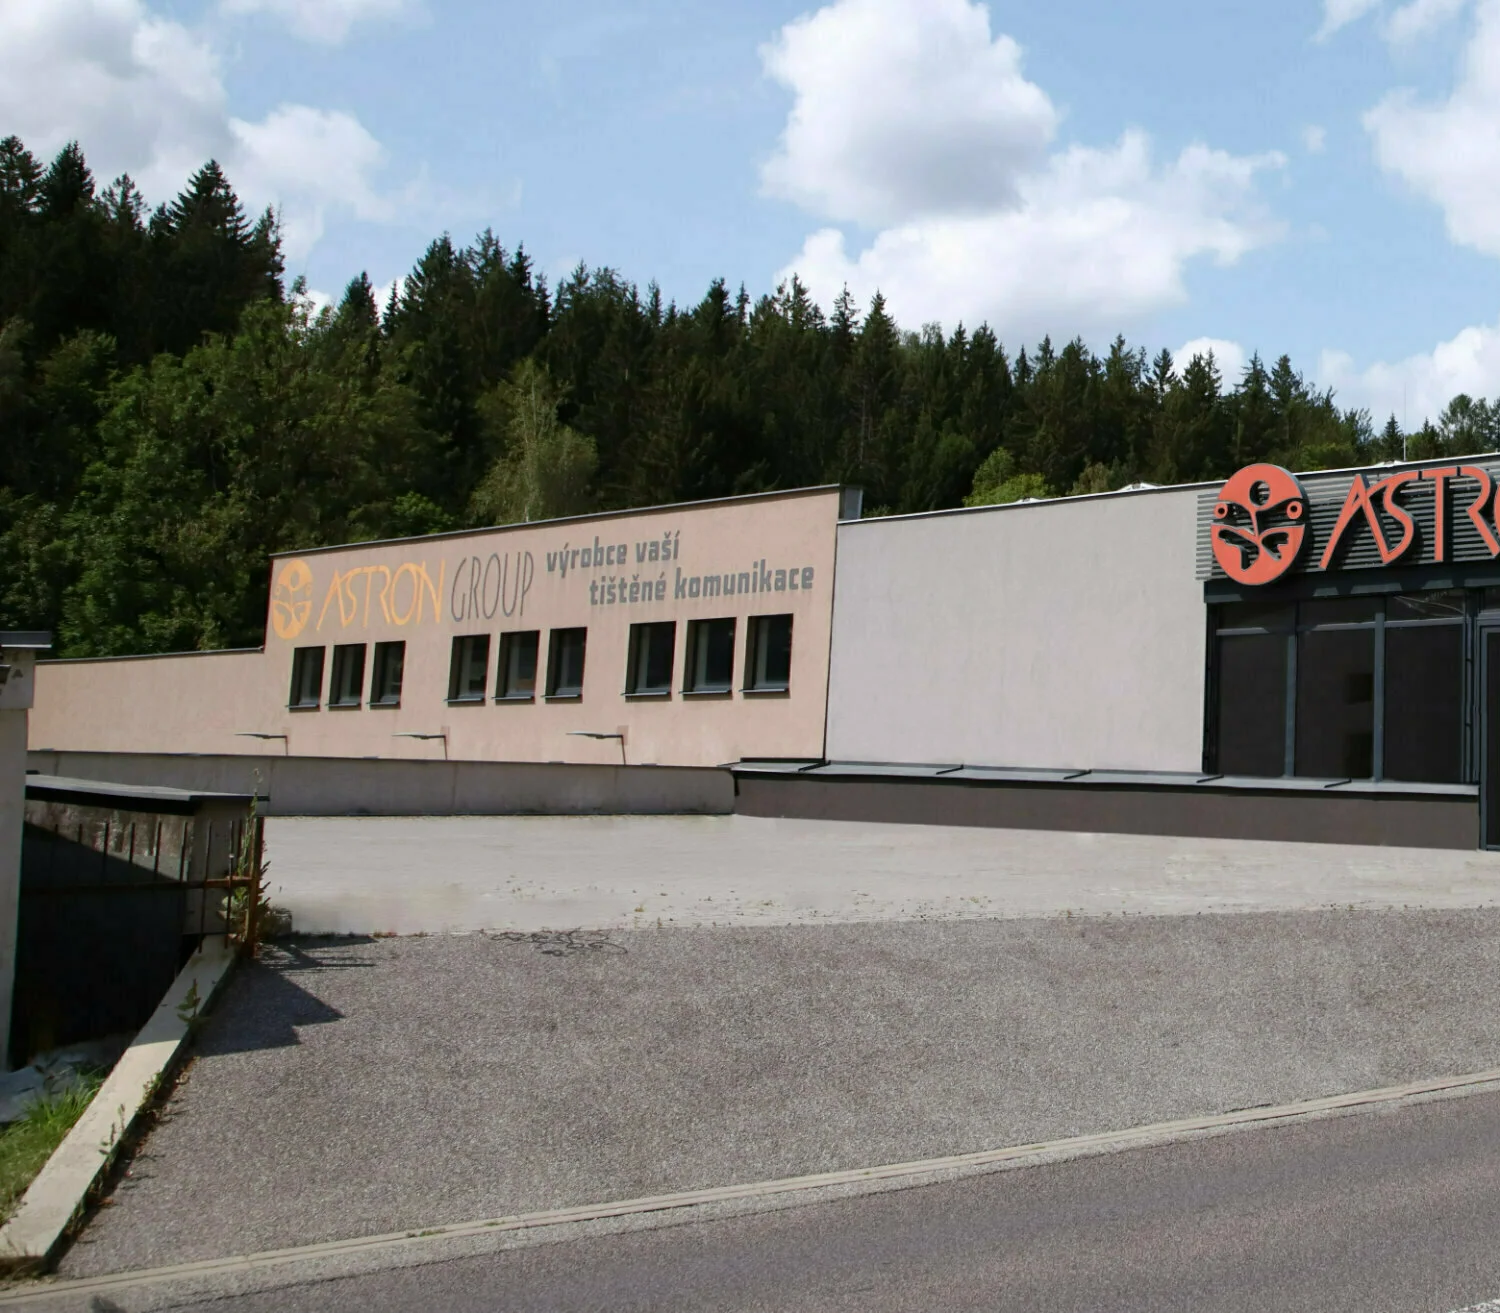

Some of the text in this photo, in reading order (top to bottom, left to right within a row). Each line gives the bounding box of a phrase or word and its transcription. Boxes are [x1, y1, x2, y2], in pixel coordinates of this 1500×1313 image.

[546, 530, 681, 579] výrobce vaší
[316, 551, 535, 631] ASTRON GROUP
[589, 558, 815, 606] tištěné komunikace
